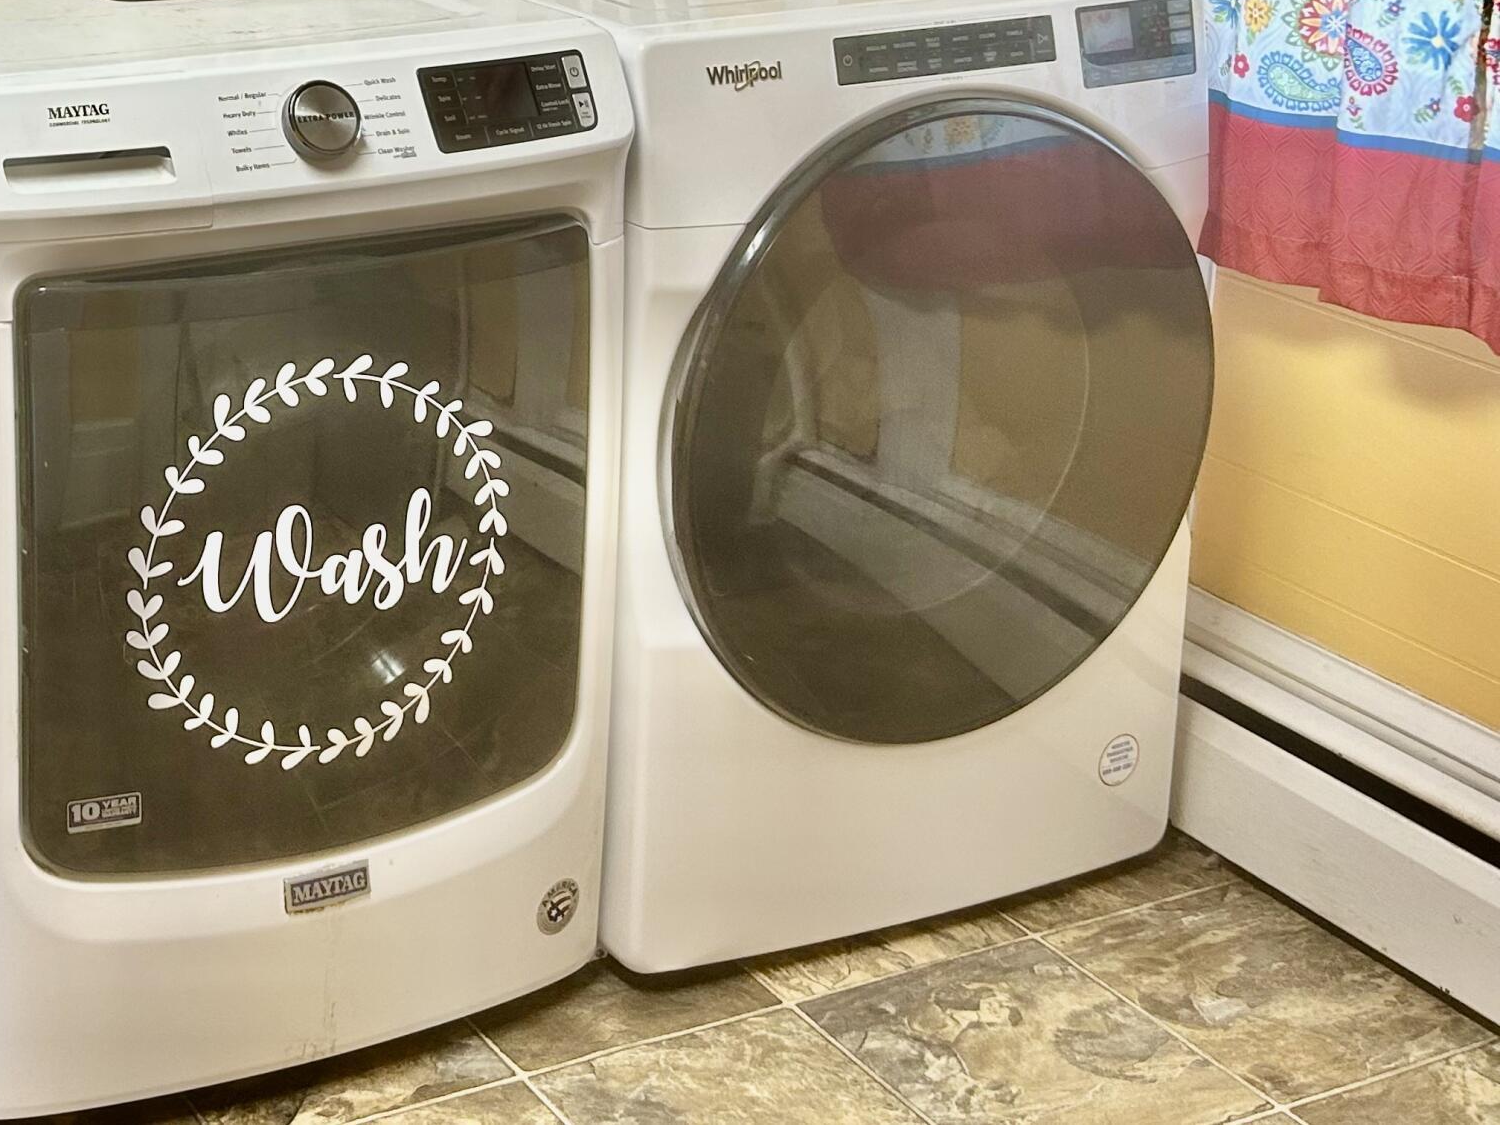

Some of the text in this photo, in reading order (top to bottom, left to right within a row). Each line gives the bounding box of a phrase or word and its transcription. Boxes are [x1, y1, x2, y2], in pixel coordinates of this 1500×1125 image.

[706, 61, 782, 88] Whirlpool
[364, 77, 396, 86] Quick Wash
[218, 91, 267, 102] Normal Regular
[375, 94, 402, 102] Delicates
[47, 103, 110, 120] MAYTAG
[223, 110, 256, 120] Heavy Duty
[385, 111, 406, 119] Control
[297, 111, 355, 123] EXTRA POWER
[227, 129, 248, 137] Whites
[375, 129, 392, 137] Drain
[231, 146, 252, 154] Towels
[378, 147, 393, 155] Clean
[235, 162, 270, 173] Bulky Items
[177, 487, 468, 623] Wash
[71, 802, 100, 823] 10
[102, 796, 137, 809] YEAR
[292, 872, 366, 904] MAYTAG
